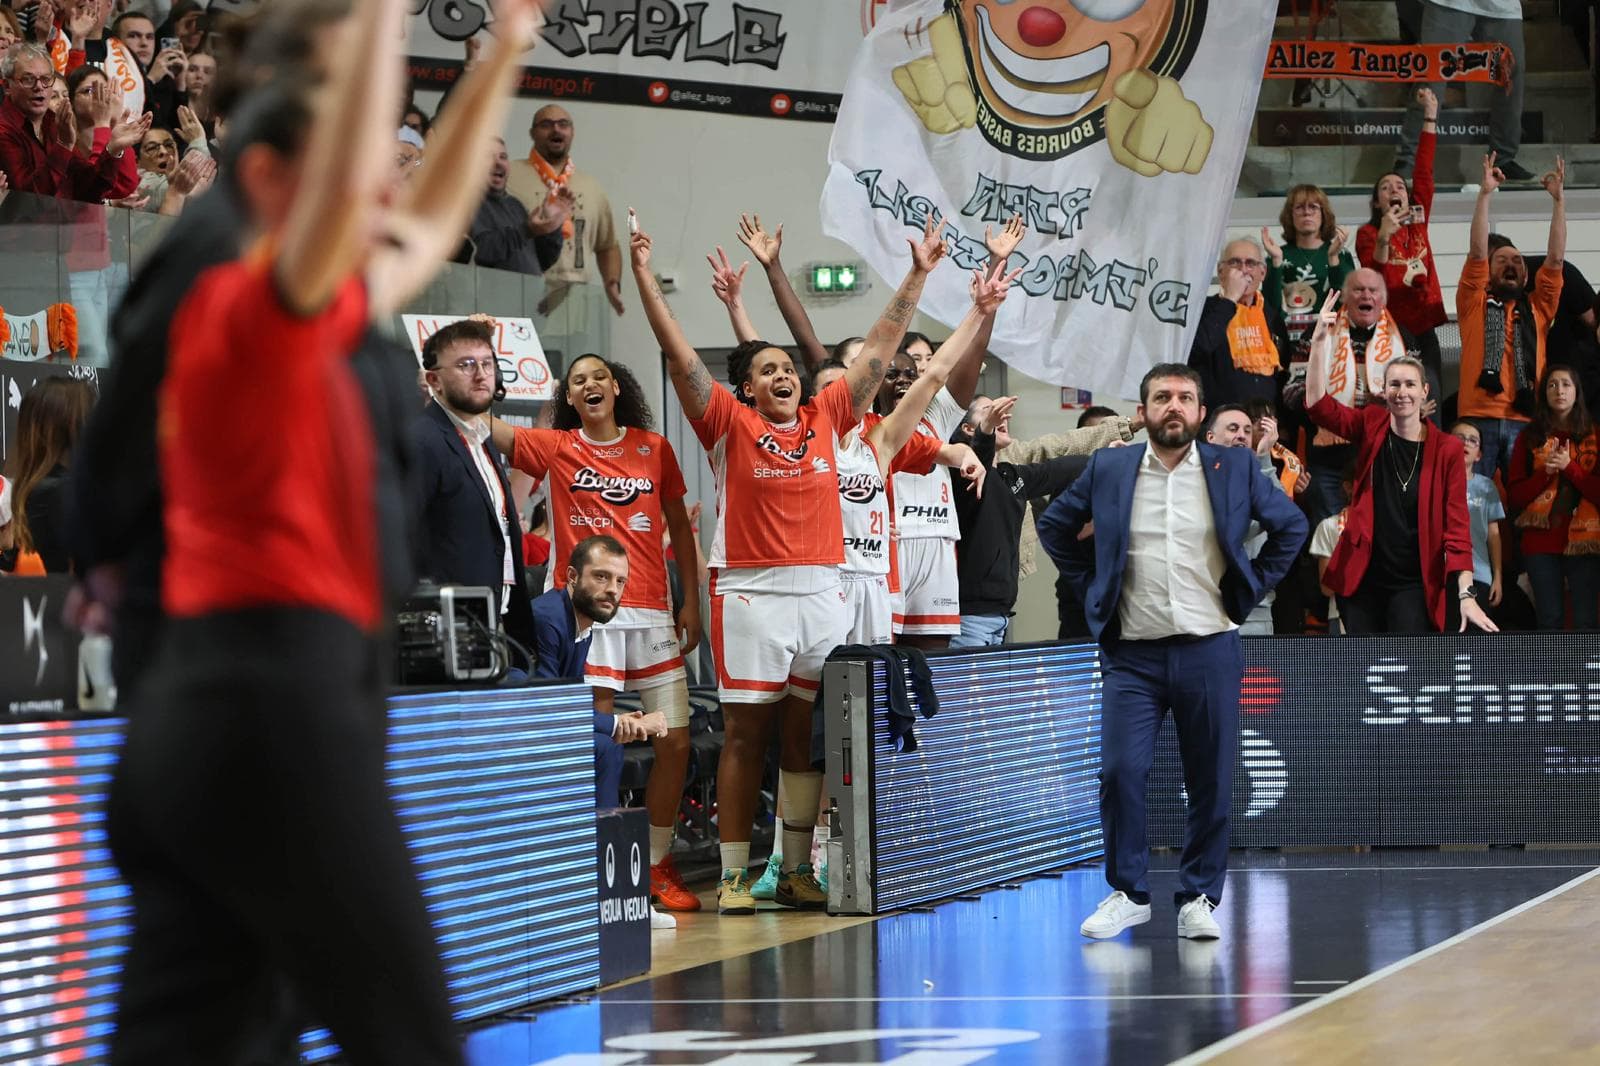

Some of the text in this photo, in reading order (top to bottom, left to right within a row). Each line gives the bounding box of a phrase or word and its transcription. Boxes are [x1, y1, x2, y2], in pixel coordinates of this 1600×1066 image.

[1268, 45, 1428, 79] Allez Tango
[1306, 124, 1352, 135] CONSEIL
[1449, 125, 1466, 135] DU
[506, 386, 545, 395] ASKET
[753, 468, 802, 479] SERCPI
[941, 482, 949, 503] 3
[902, 505, 948, 518] PHM
[569, 514, 614, 529] SERCPI
[870, 510, 883, 535] 21
[843, 537, 882, 552] PHM
[600, 895, 648, 924] VEOLIA VEOLIA
